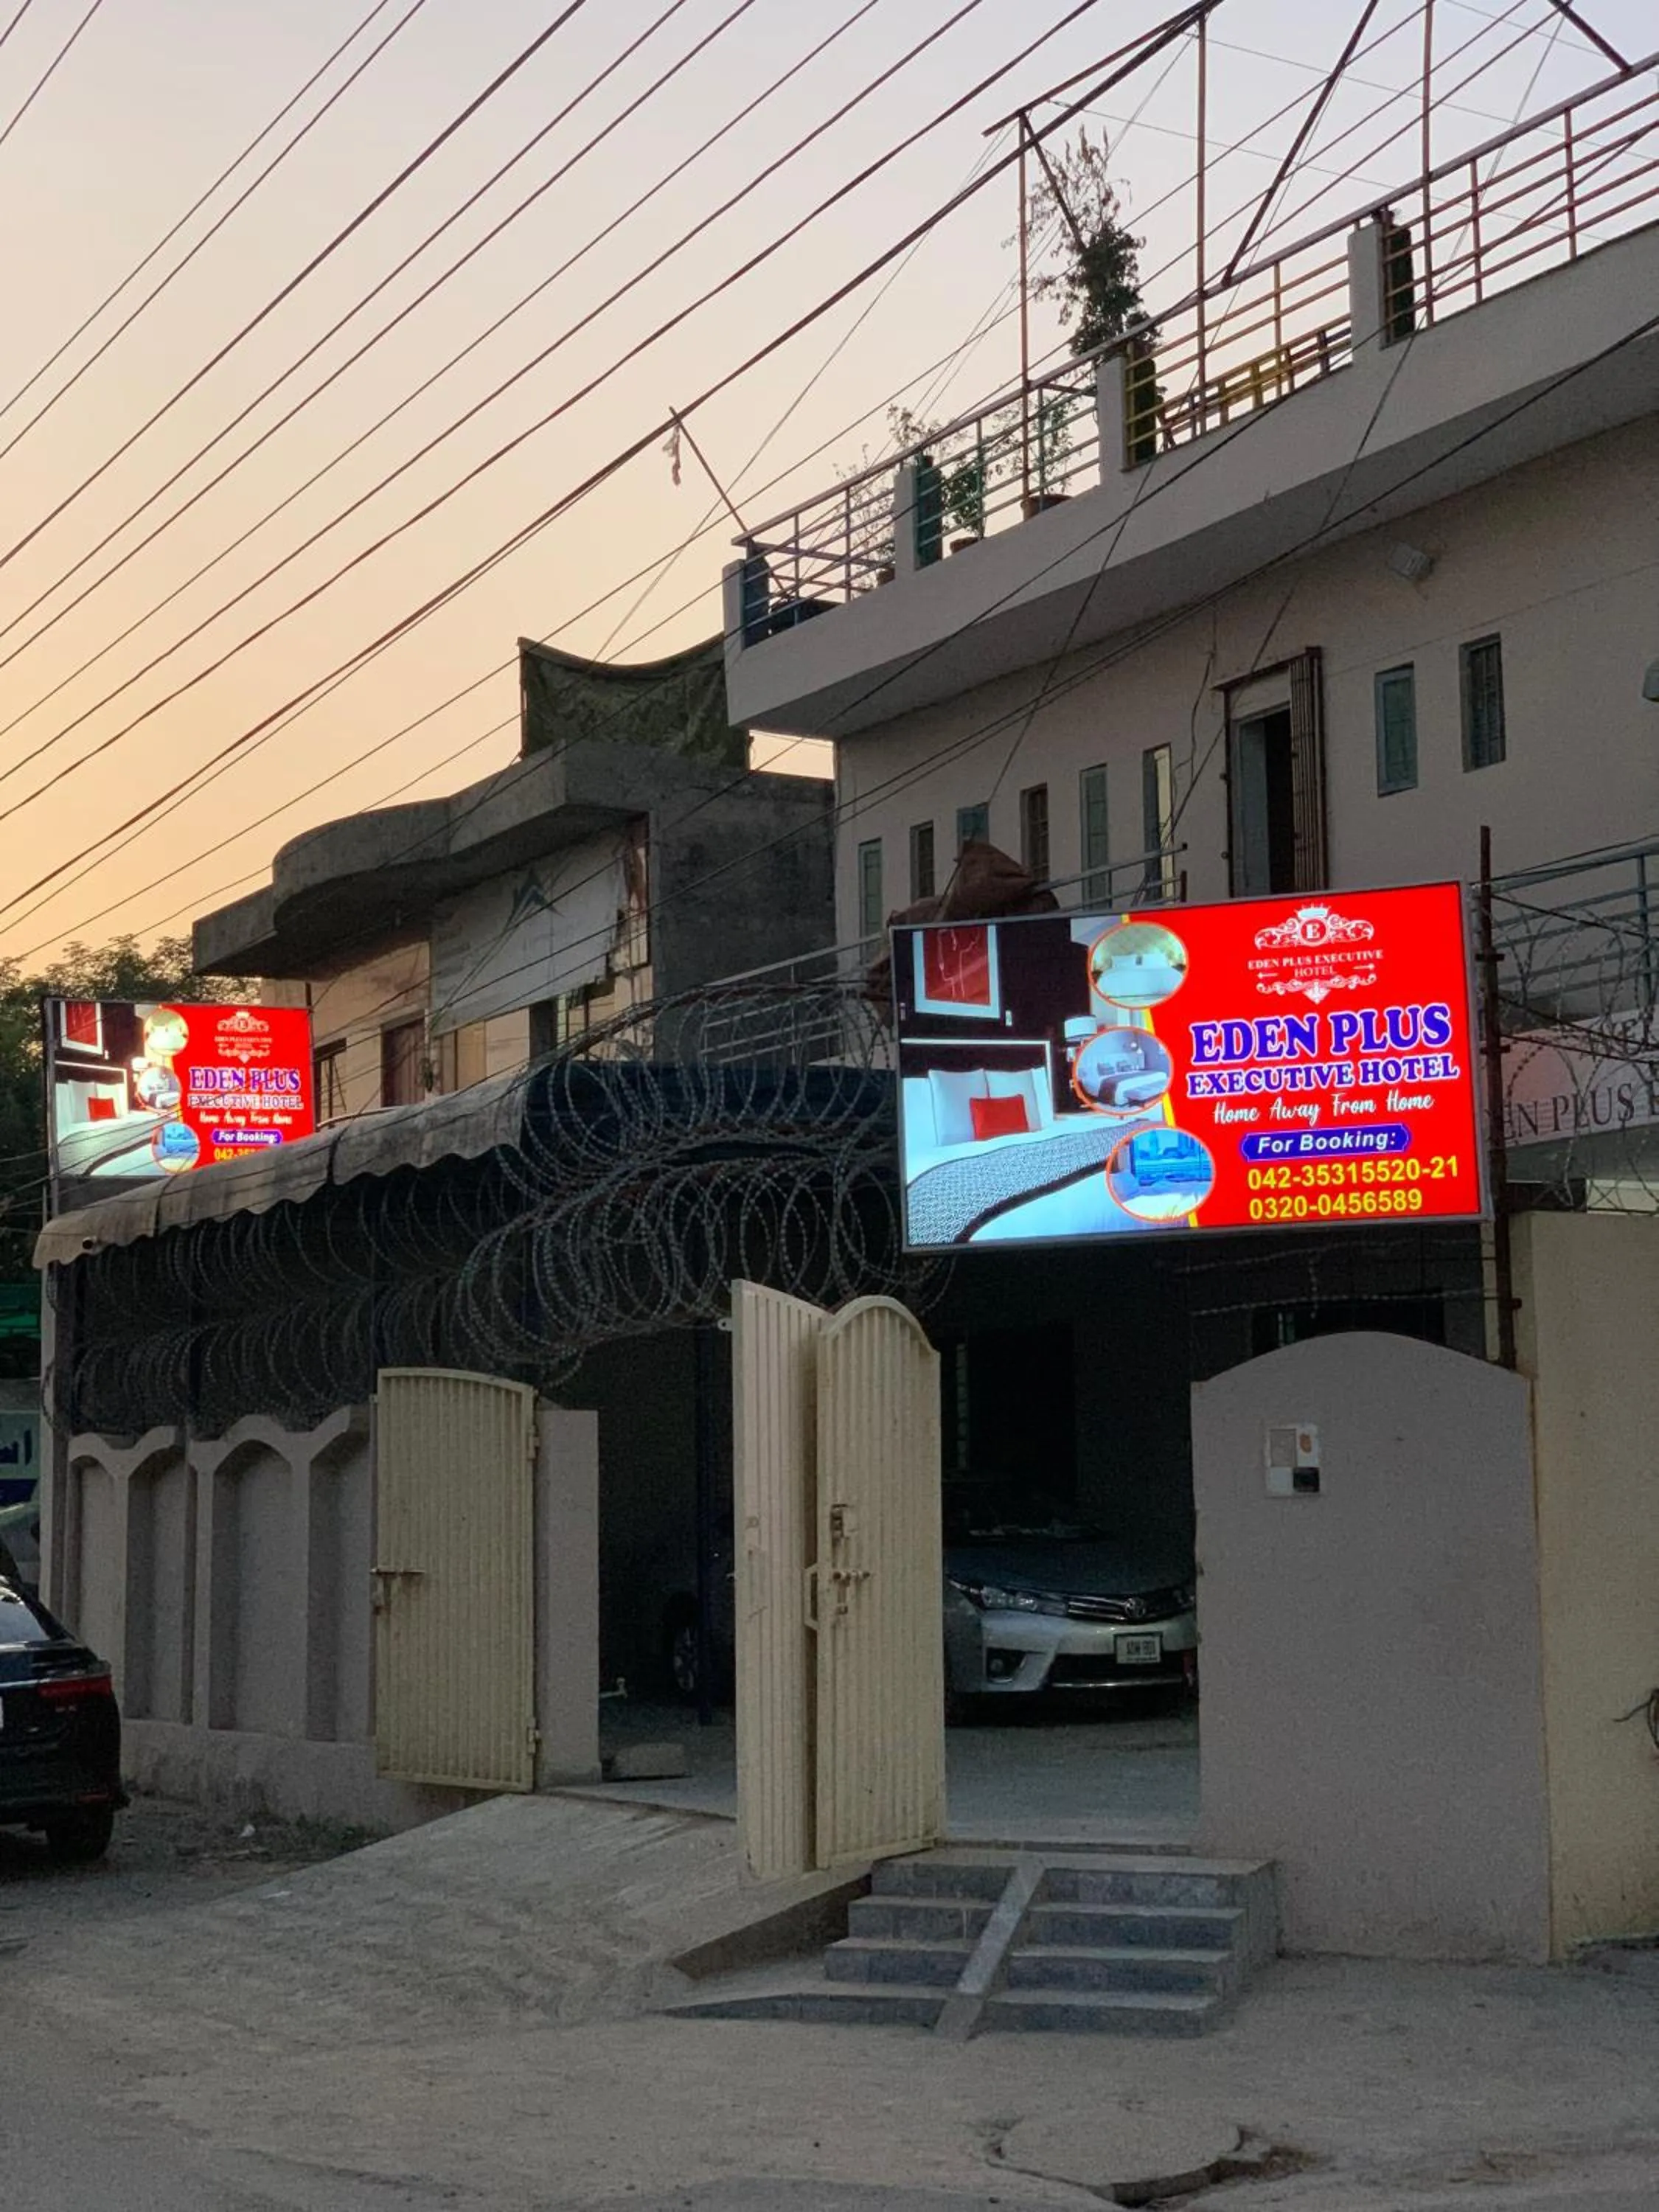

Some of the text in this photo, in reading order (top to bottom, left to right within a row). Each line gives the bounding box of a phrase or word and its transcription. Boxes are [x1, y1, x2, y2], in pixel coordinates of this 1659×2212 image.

[1306, 922, 1321, 939] E
[1248, 948, 1384, 970] EDEN PLUS EXECUTIVE
[1294, 965, 1337, 978] HOTEL
[1189, 1003, 1453, 1066] EDEN PLUS
[189, 1066, 302, 1093] EDEN PLUS
[1186, 1053, 1460, 1099] EXECUTIVE HOTEL
[187, 1093, 304, 1110] EXECUTIVE HOTEL
[1213, 1089, 1435, 1127] Home Away From Home
[1552, 1082, 1635, 1132] PLUS
[218, 1131, 278, 1144] For Booking:
[1257, 1130, 1397, 1155] For Booking:
[1247, 1155, 1458, 1190] 042-35315520-21
[1249, 1188, 1423, 1220] 0320-0456589
